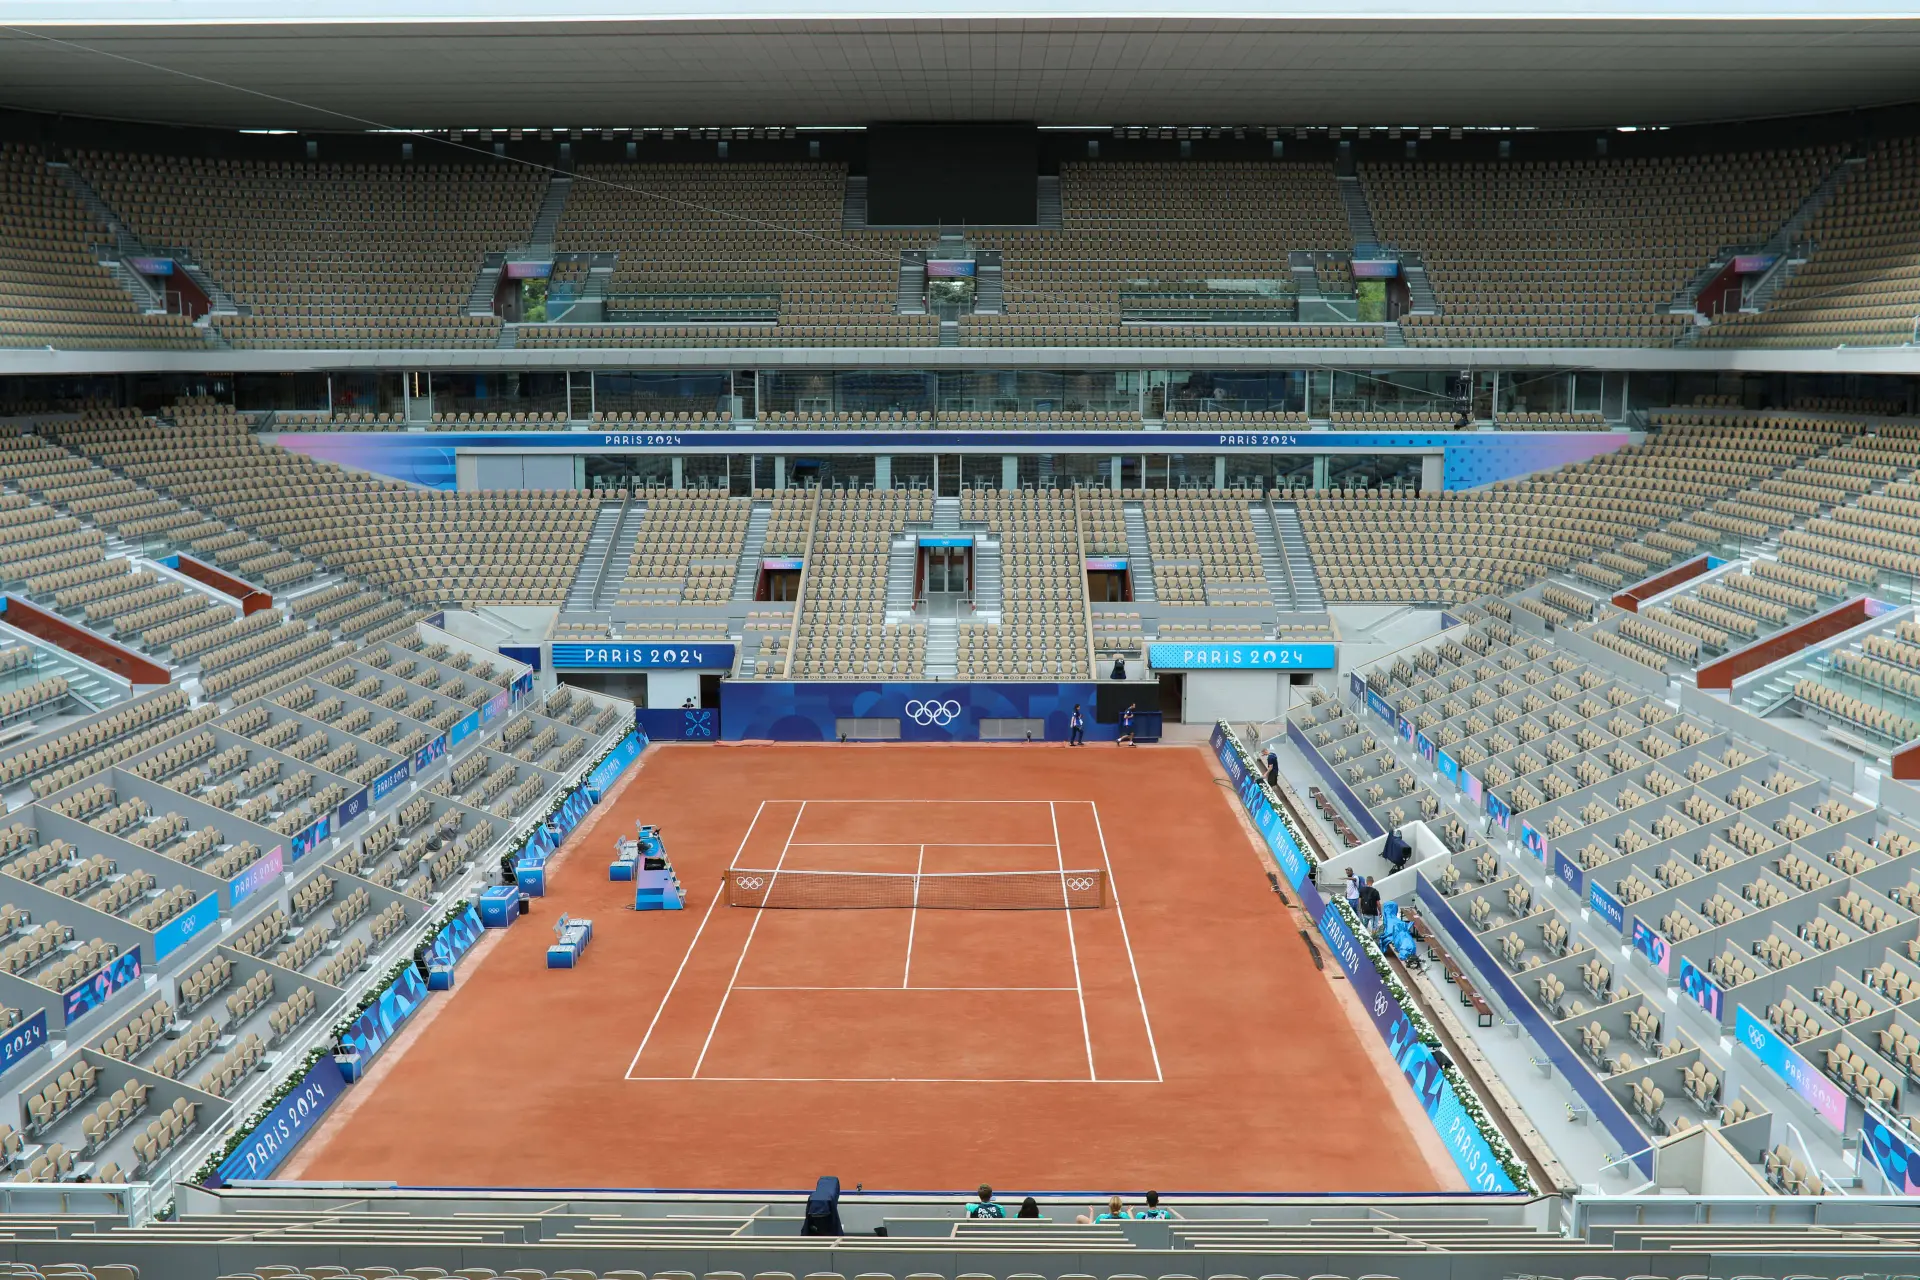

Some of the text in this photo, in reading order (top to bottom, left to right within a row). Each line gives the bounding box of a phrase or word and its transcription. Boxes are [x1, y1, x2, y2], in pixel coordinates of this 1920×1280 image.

[647, 435, 681, 445] 2024
[1262, 435, 1296, 445] 2024
[650, 649, 702, 663] 2024
[1250, 650, 1303, 664] 2024
[1341, 941, 1360, 975] 2024
[5, 1025, 40, 1060] 2024
[288, 1083, 325, 1128] 2024
